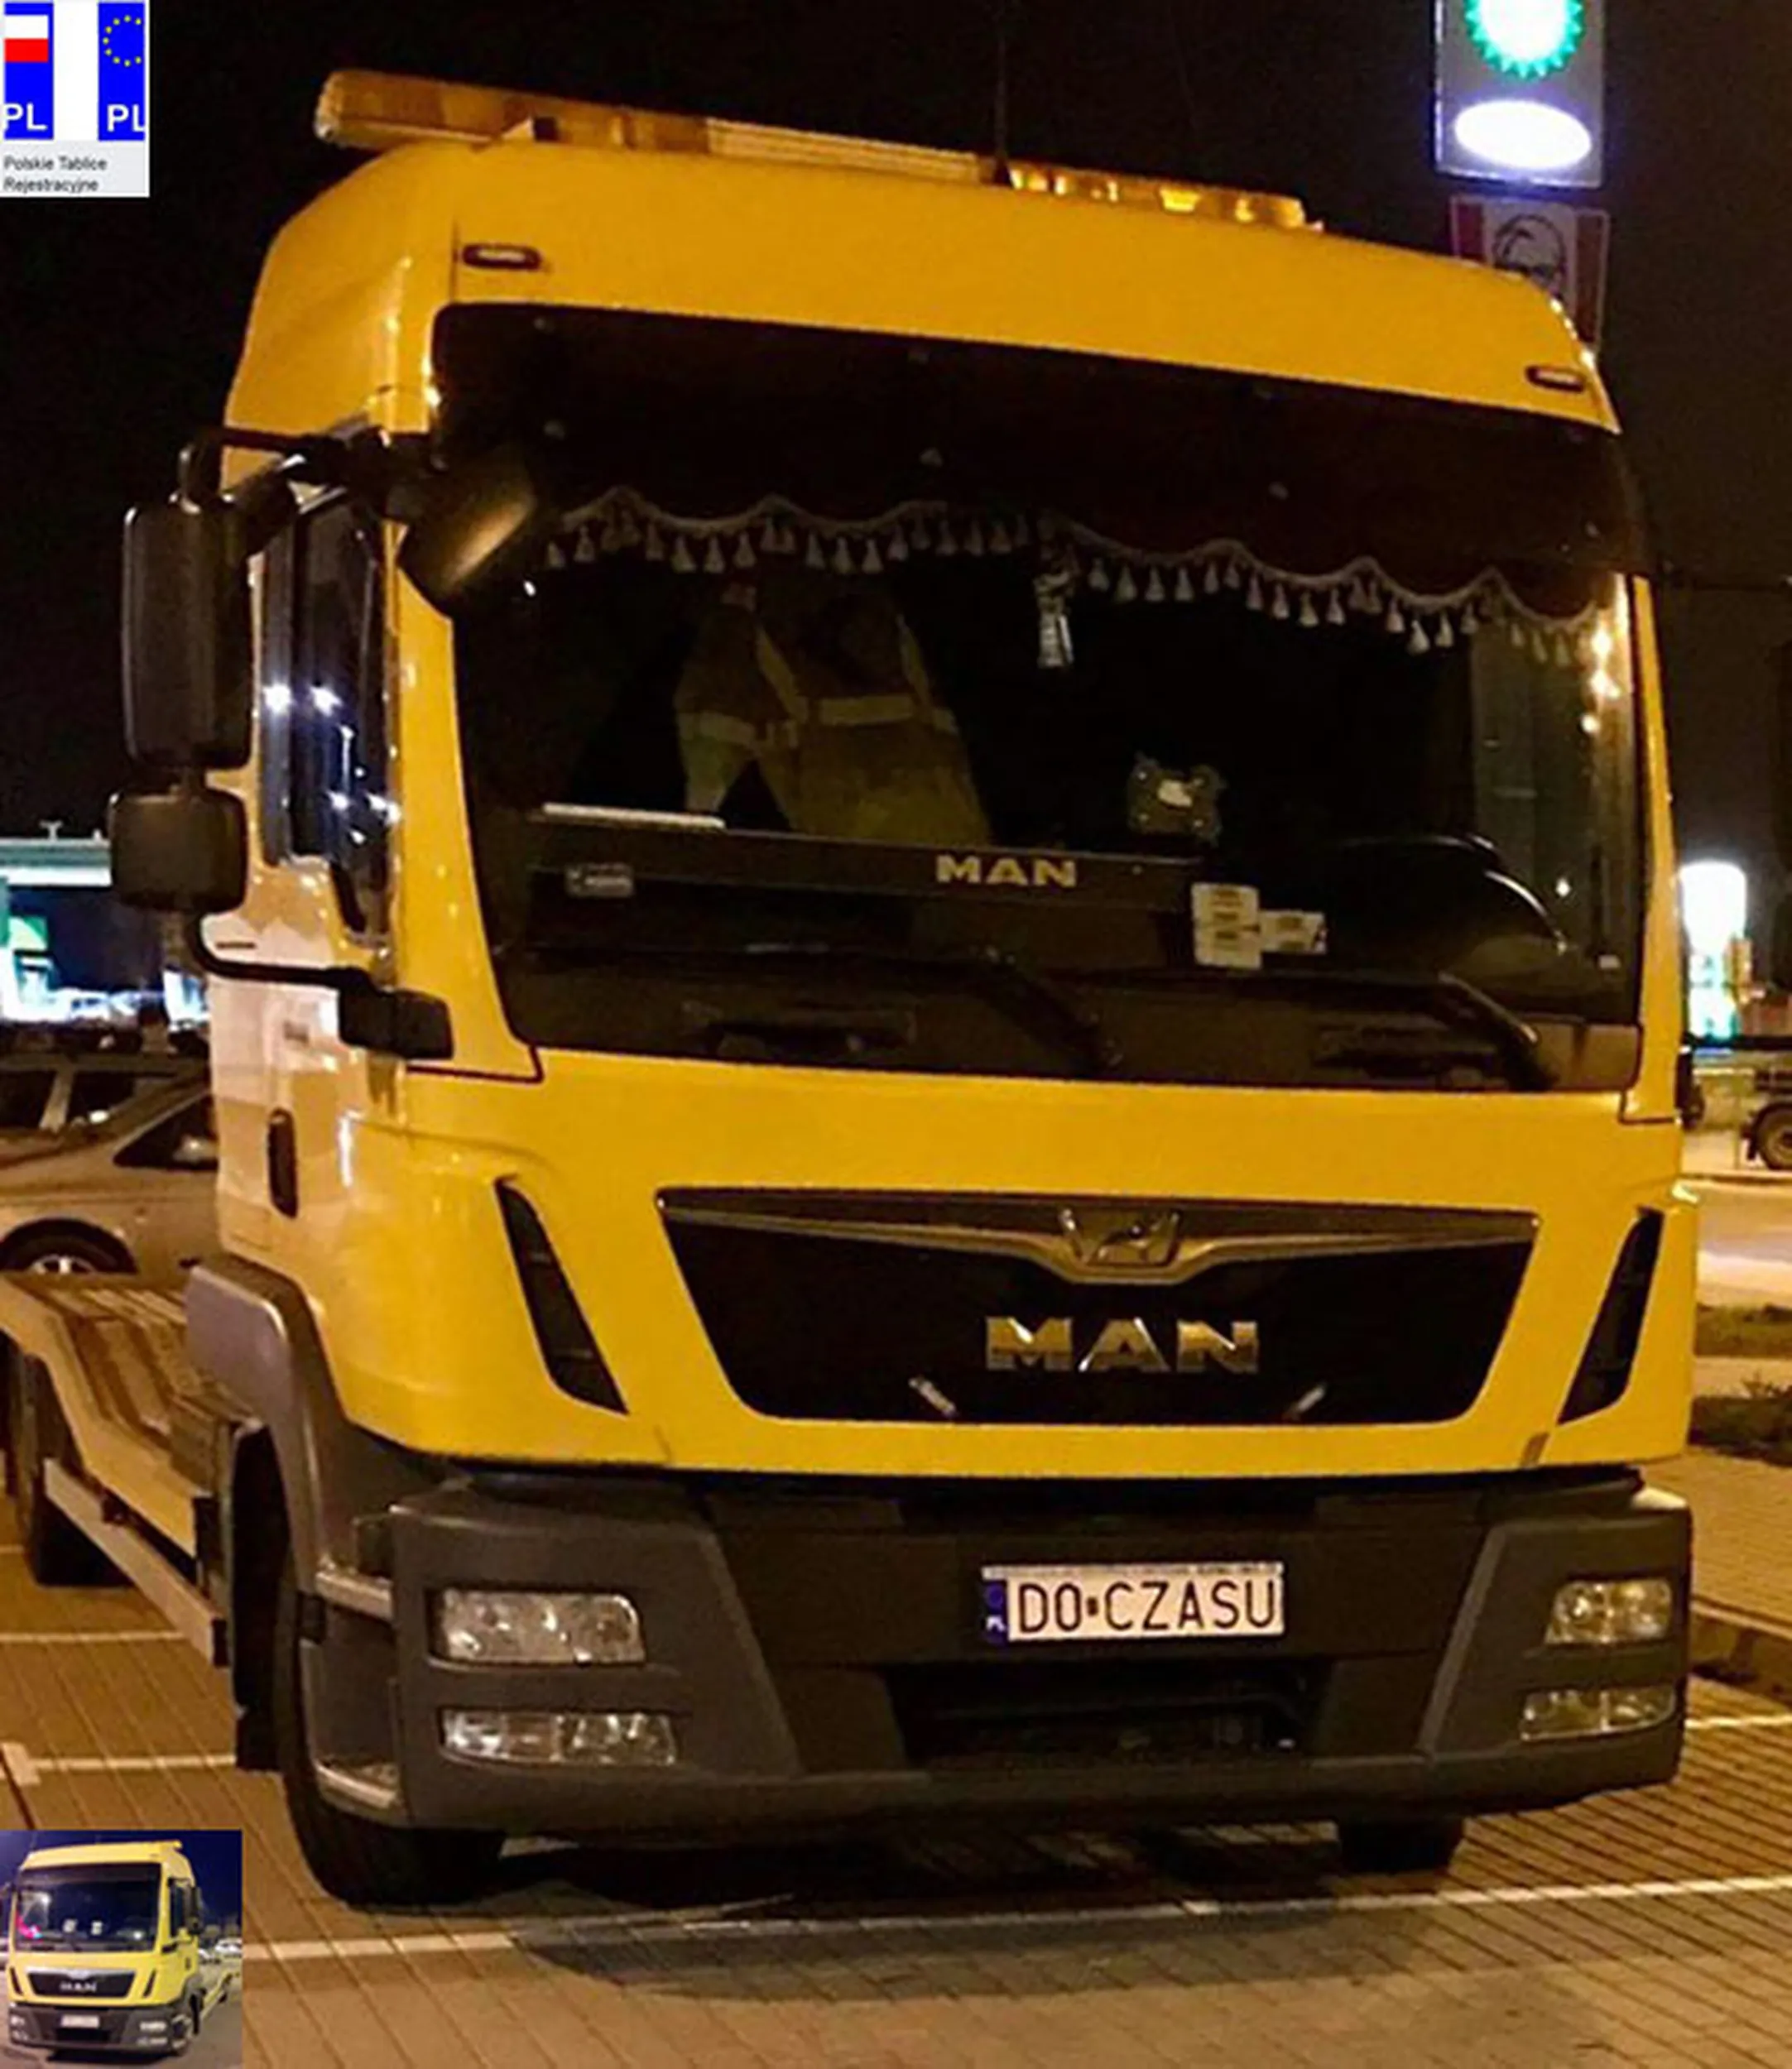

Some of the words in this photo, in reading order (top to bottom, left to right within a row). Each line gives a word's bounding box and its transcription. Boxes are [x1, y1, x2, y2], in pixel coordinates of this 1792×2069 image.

[935, 855, 1078, 887] MAN
[985, 1316, 1259, 1374] MAN
[1018, 1582, 1082, 1633] DO
[1104, 1580, 1276, 1630] CZASU
